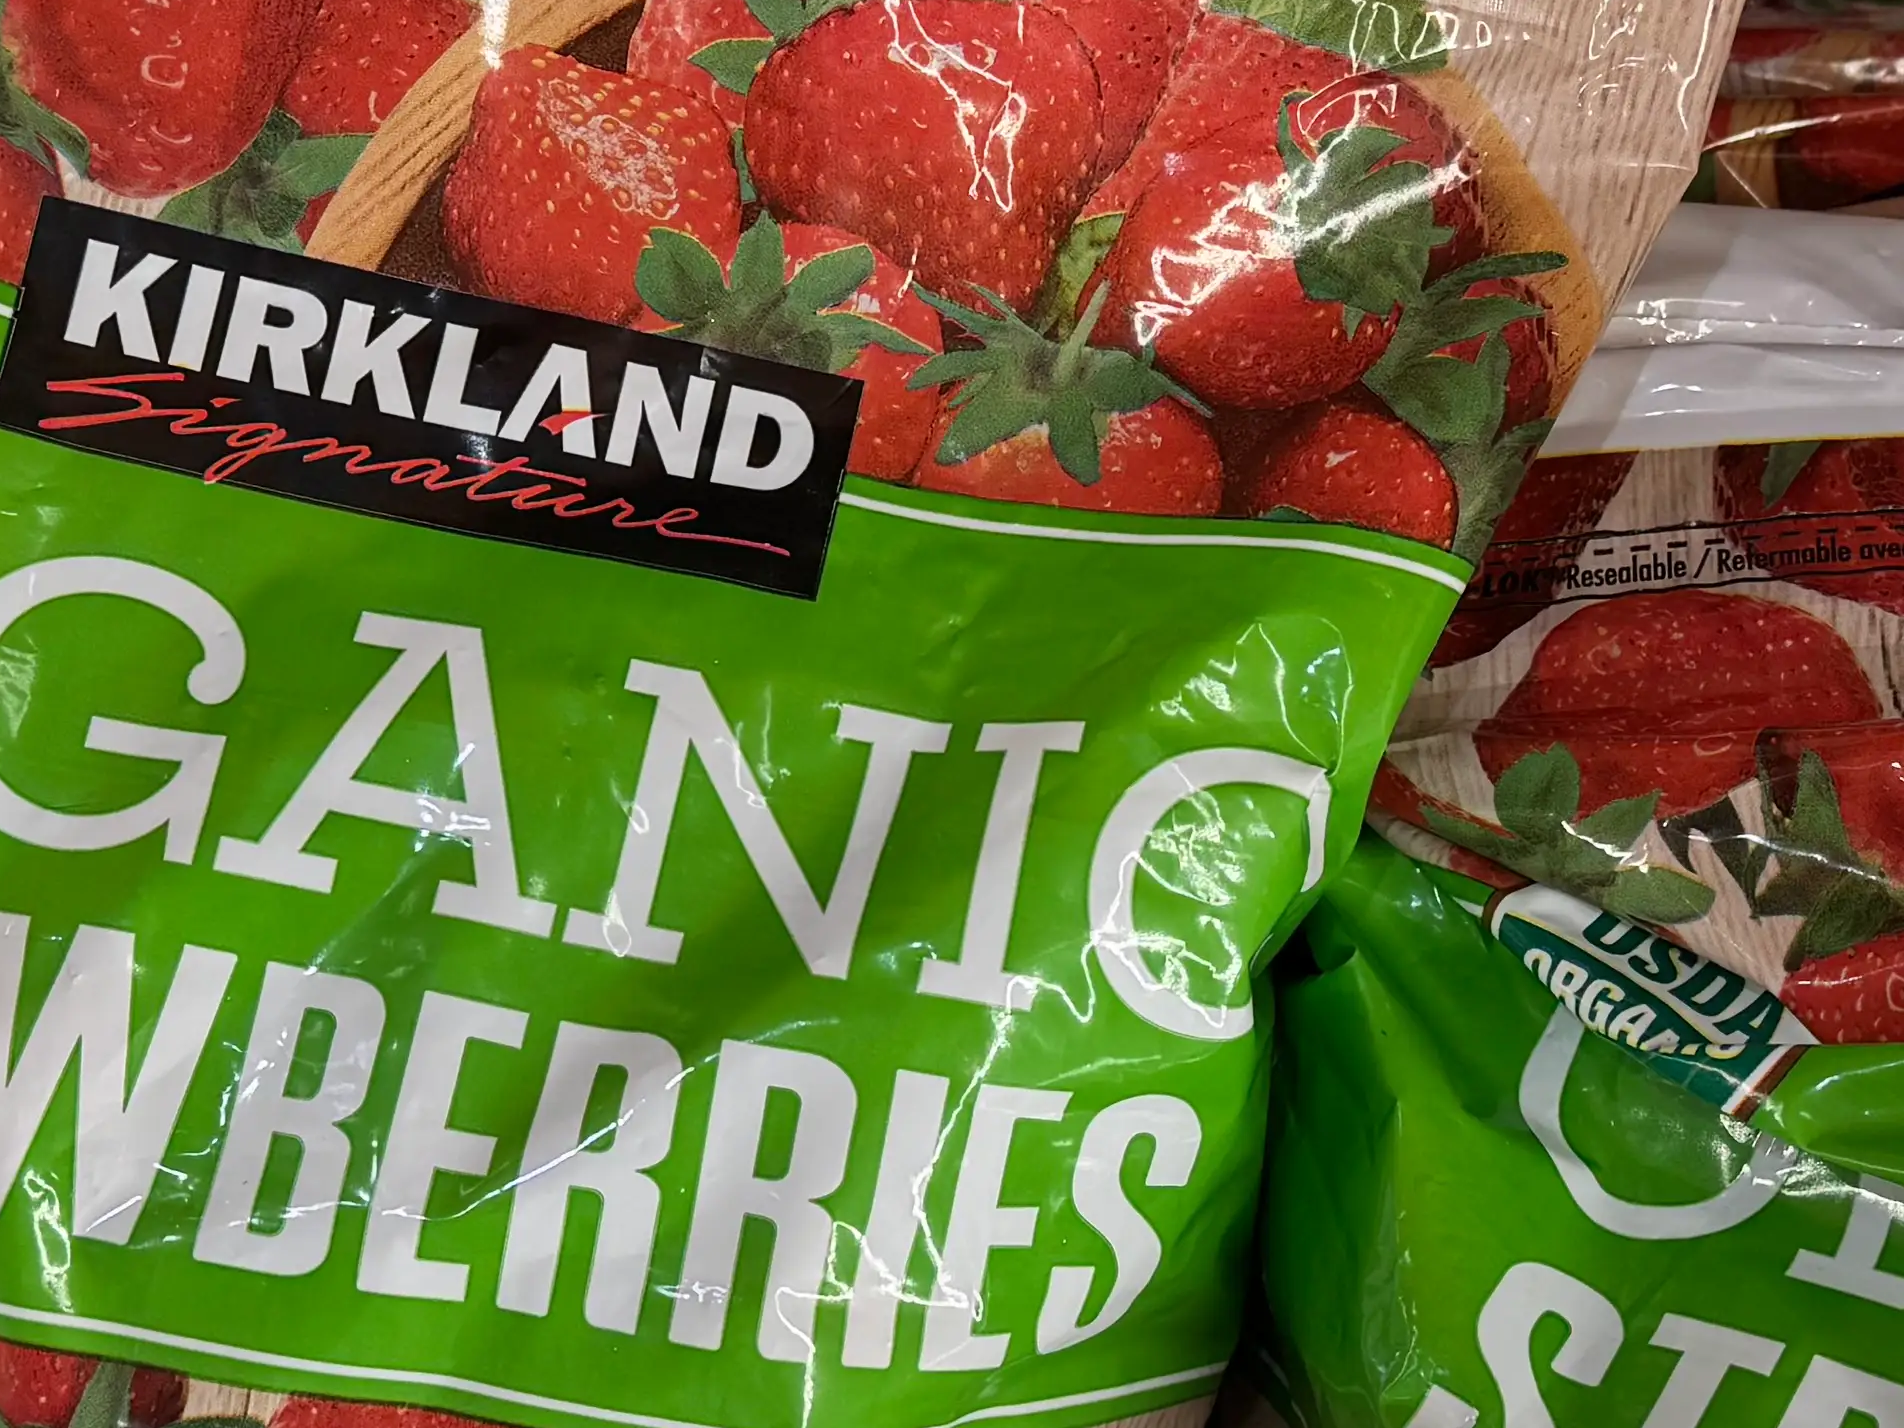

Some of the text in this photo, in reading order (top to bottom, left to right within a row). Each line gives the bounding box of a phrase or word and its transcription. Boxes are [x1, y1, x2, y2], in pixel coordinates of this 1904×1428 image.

[62, 238, 817, 494] KIRKLAND
[38, 370, 793, 558] Signature
[1566, 552, 1688, 591] Resealable
[1716, 537, 1852, 574] Refermable
[1582, 910, 1785, 1045] USDA
